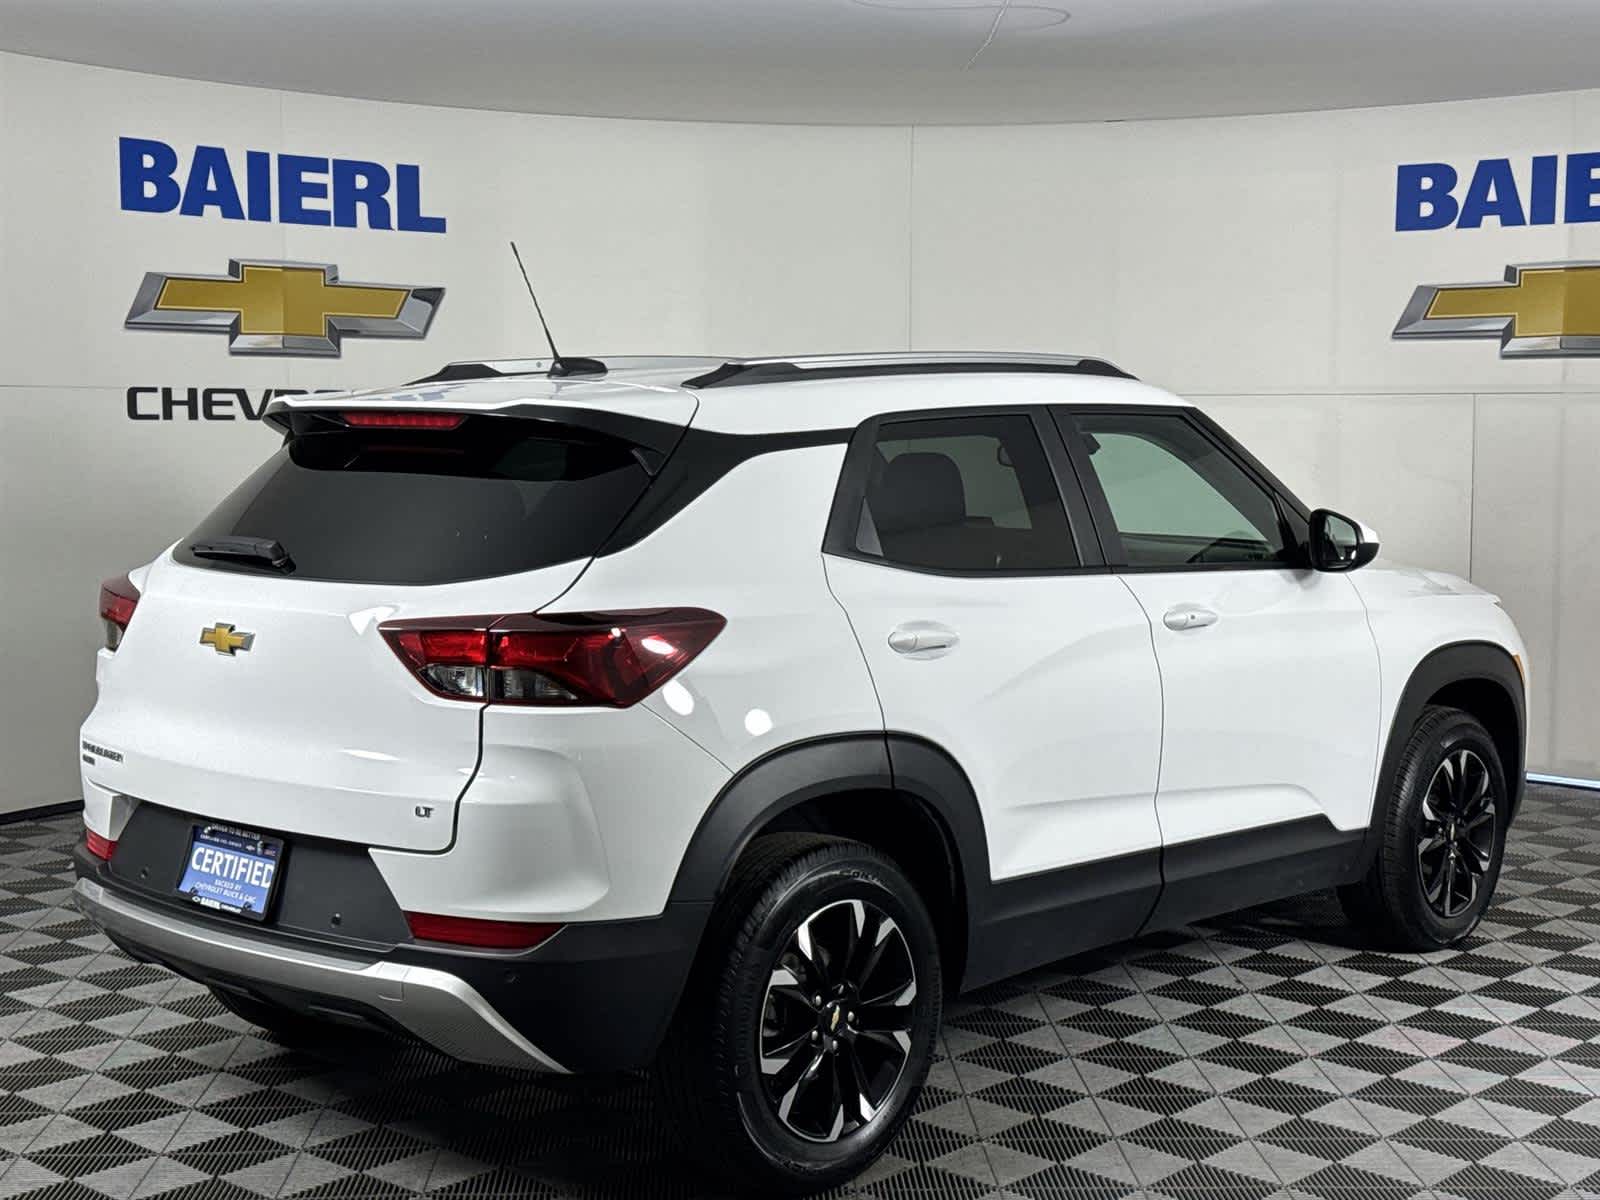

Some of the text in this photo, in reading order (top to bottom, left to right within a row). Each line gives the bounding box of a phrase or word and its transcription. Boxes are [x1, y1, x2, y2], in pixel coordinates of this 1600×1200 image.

[119, 136, 446, 233] BAIERL
[1395, 152, 1600, 232] BAIE
[415, 806, 434, 818] LT
[191, 847, 275, 888] CERTIFIED
